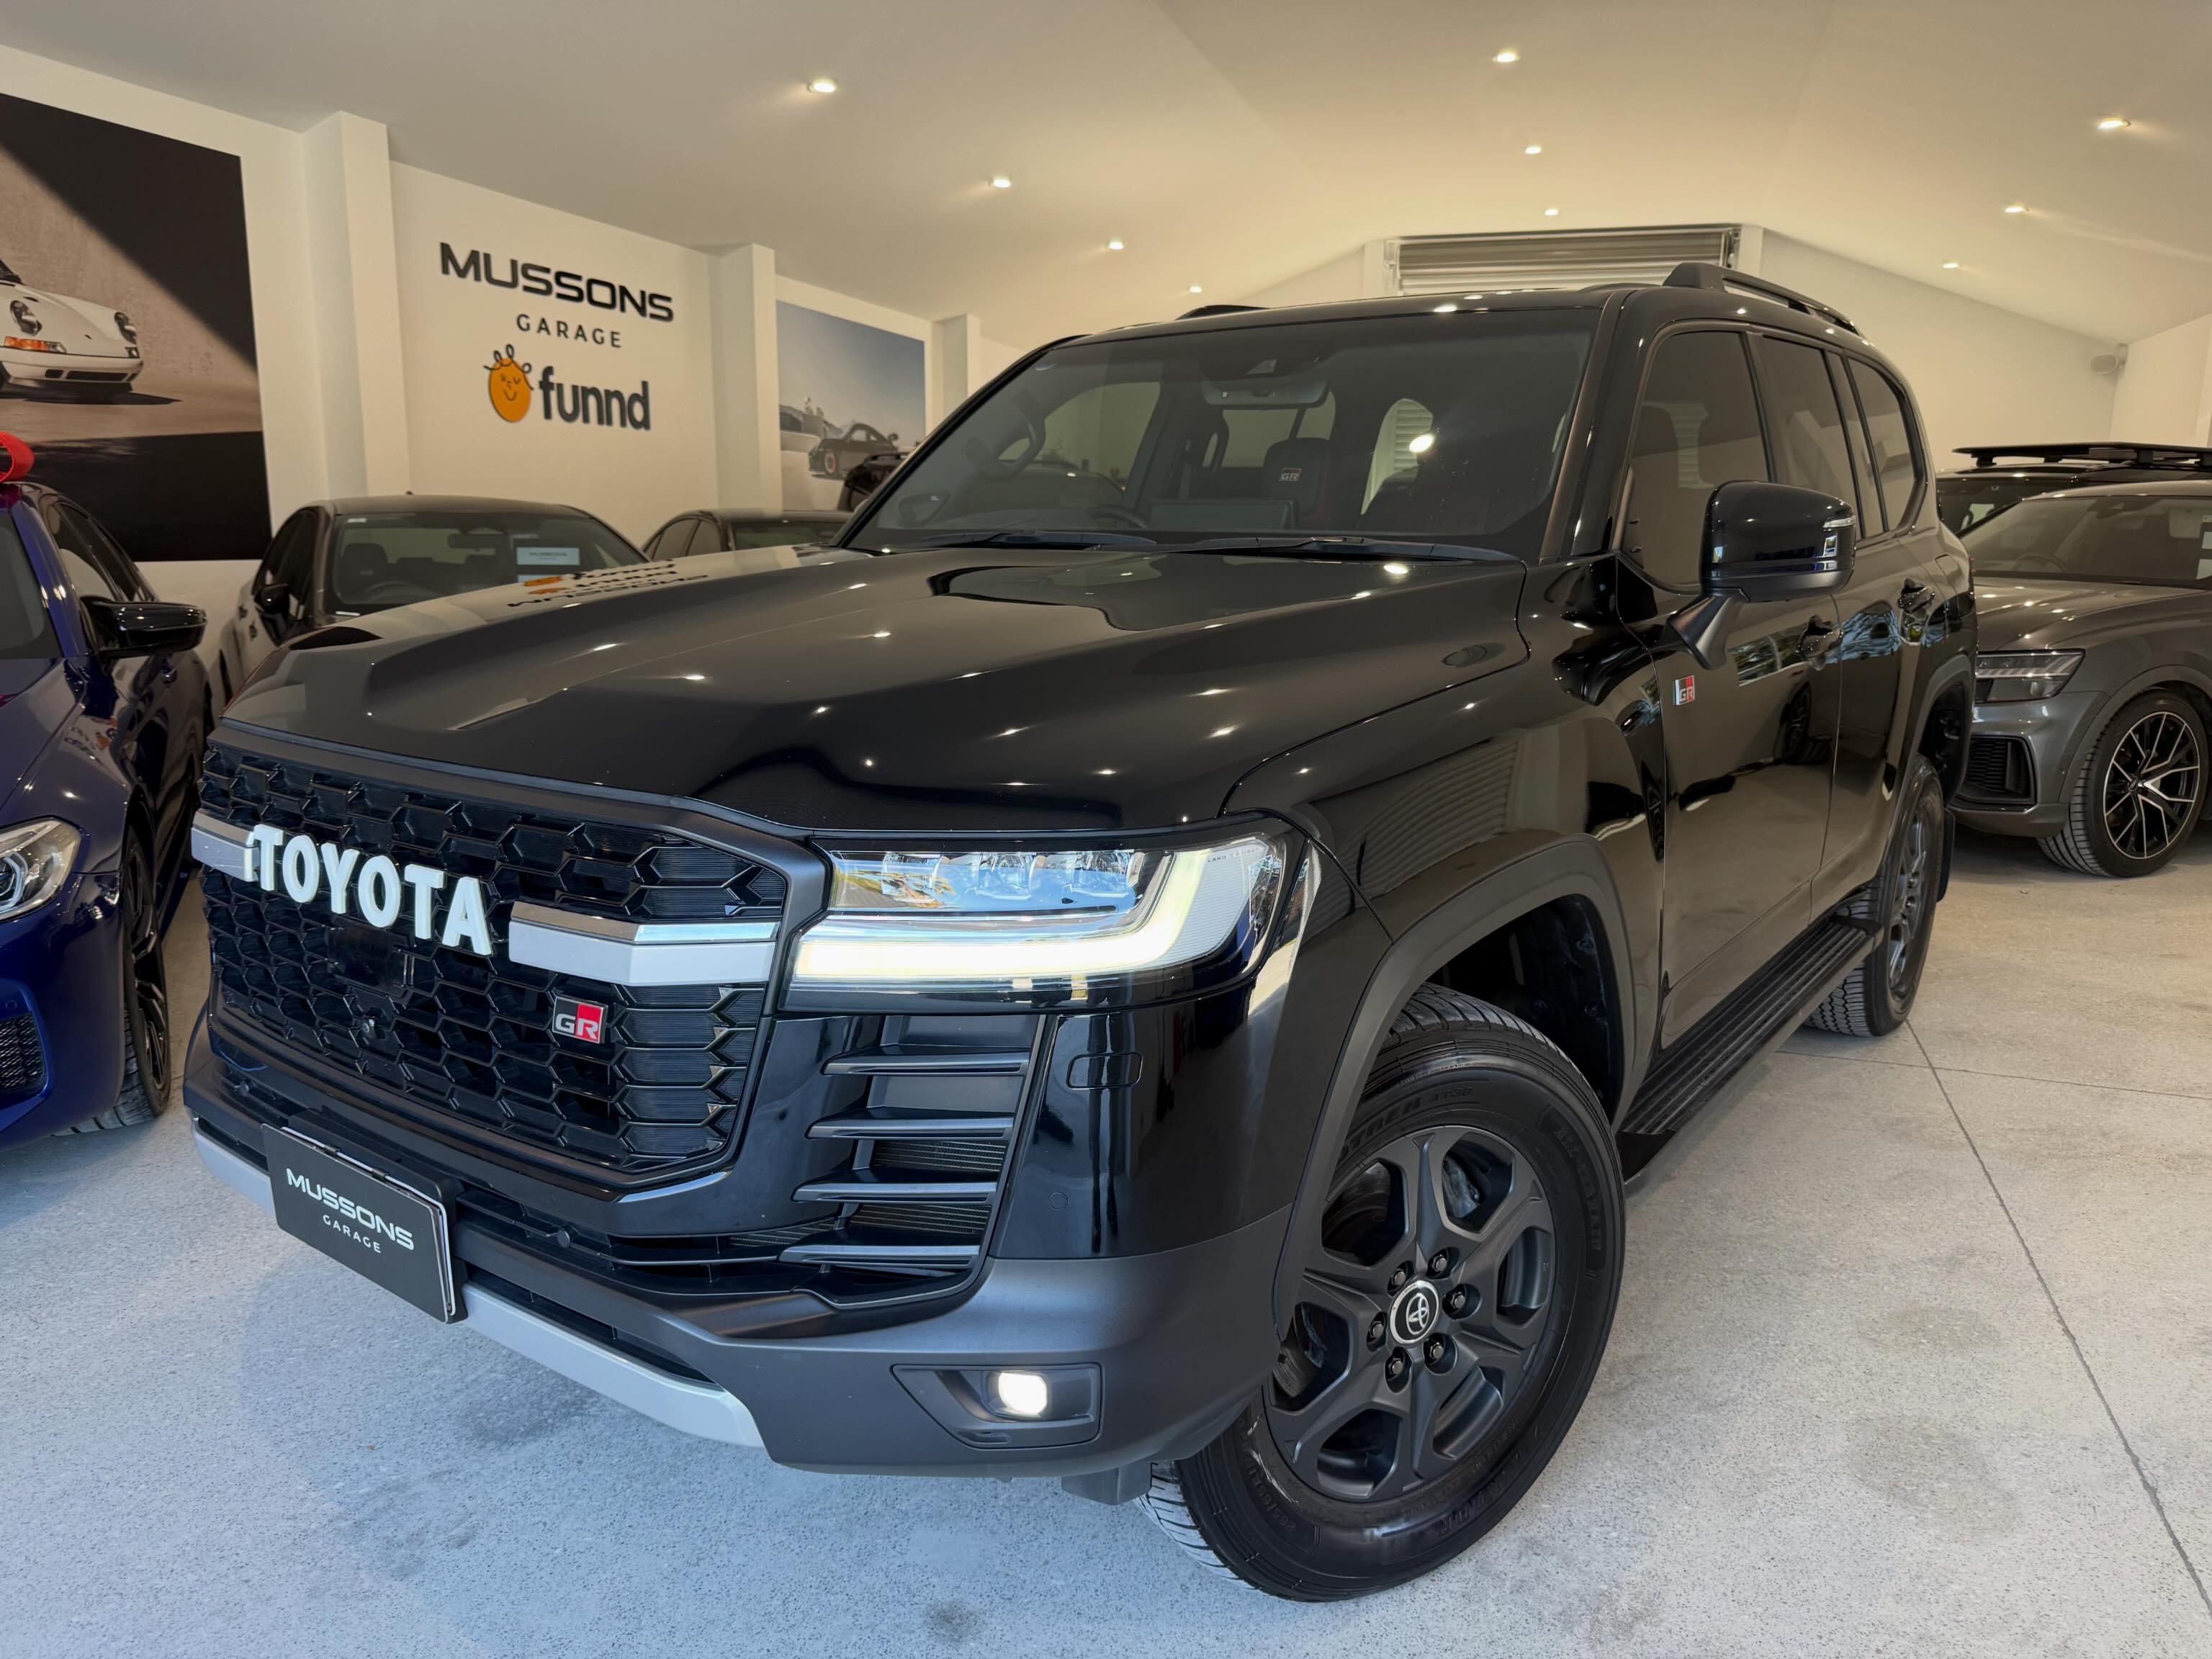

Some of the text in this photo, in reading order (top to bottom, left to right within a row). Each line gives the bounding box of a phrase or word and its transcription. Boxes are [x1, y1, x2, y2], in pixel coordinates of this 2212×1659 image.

[439, 242, 674, 323] MUSSONS
[516, 314, 622, 348] GARAGE
[539, 366, 652, 431] funnd
[253, 823, 494, 956] TOYOTA
[286, 1168, 415, 1251] MUSSONS
[323, 1215, 382, 1254] GARAGE
